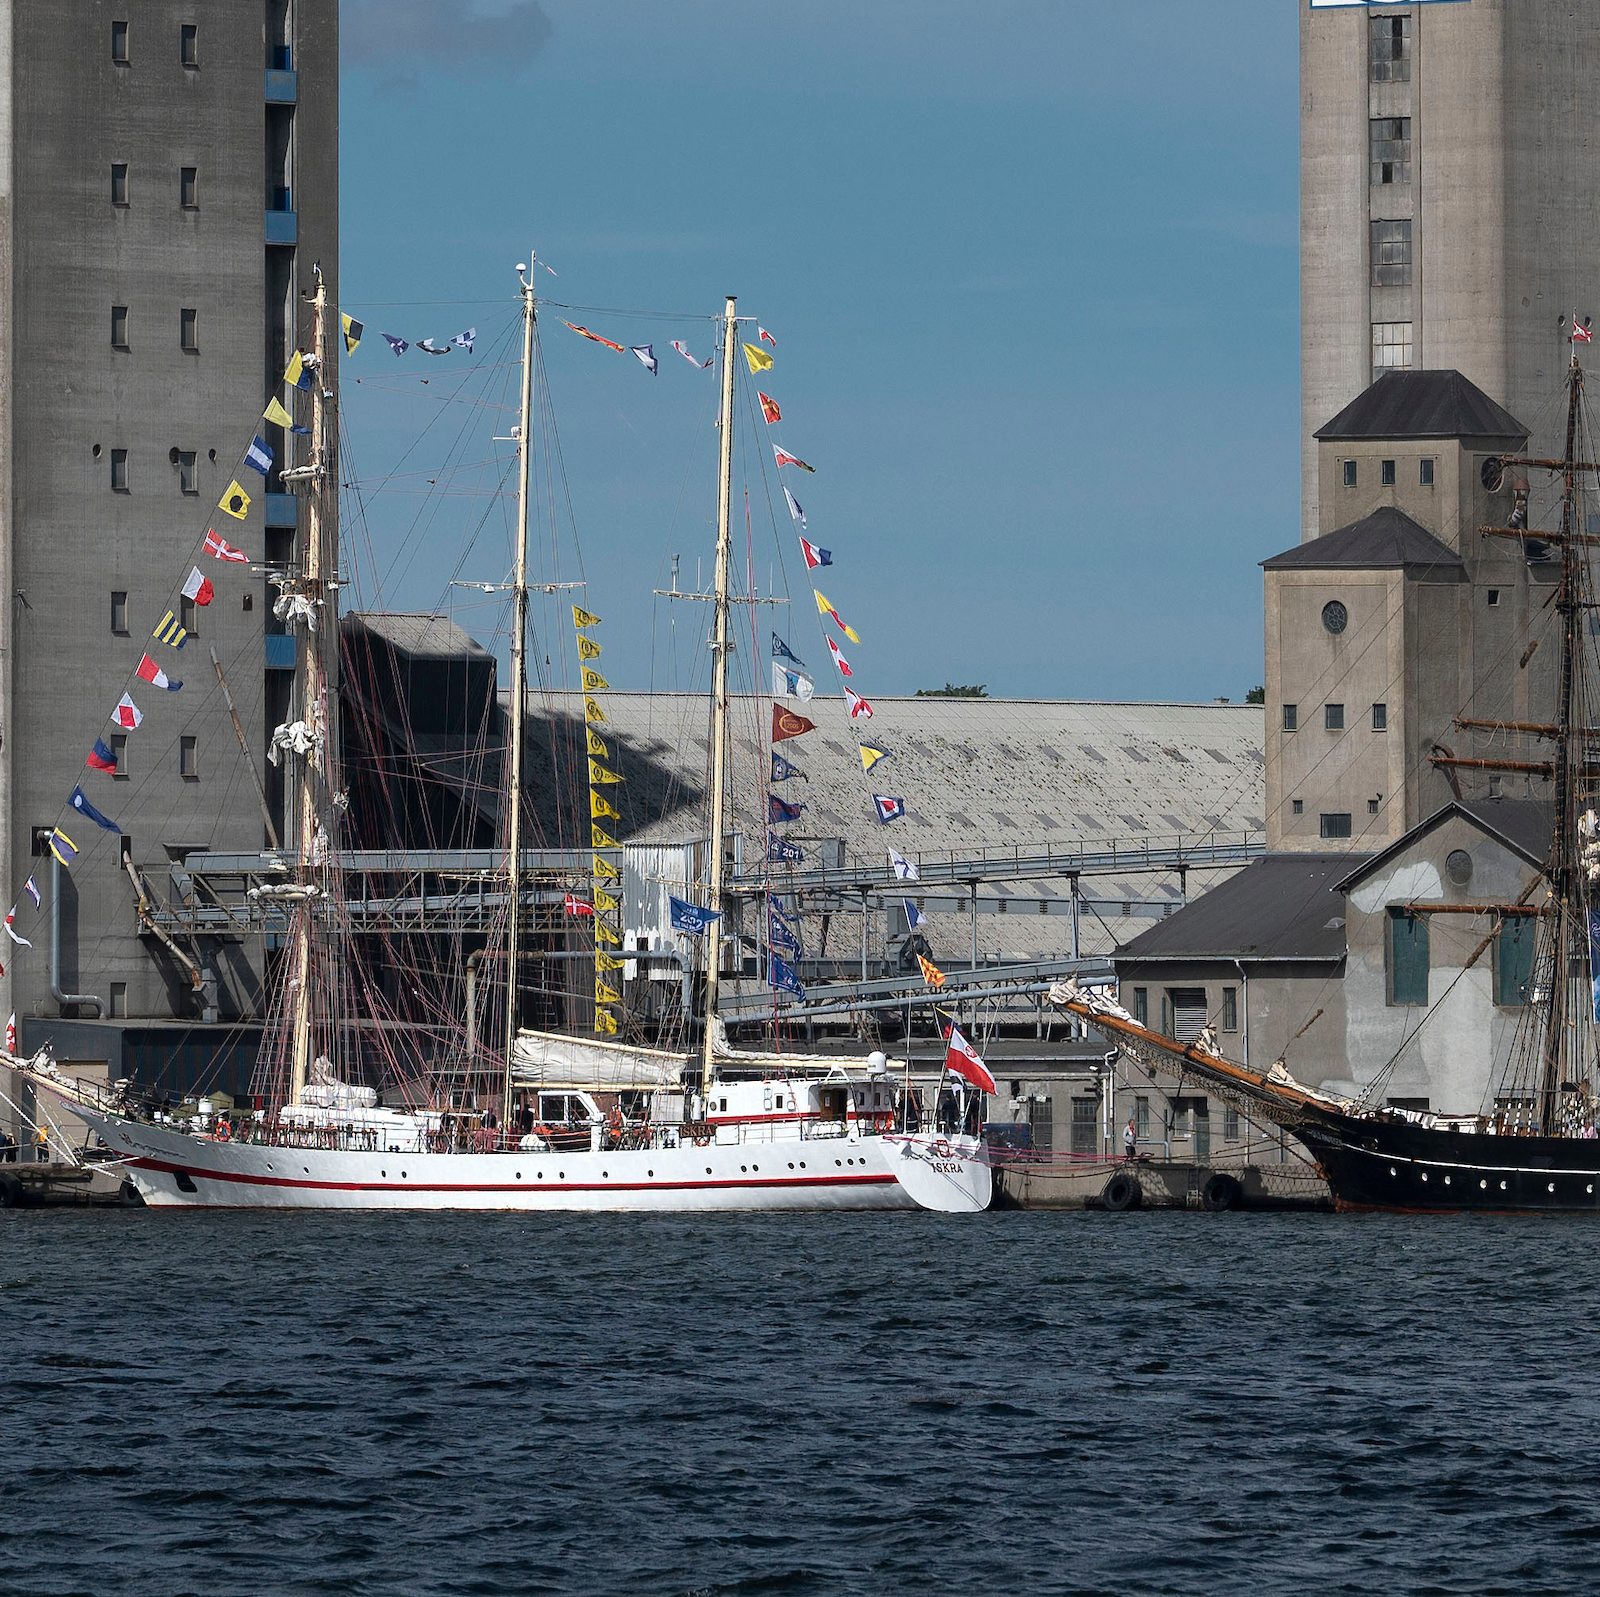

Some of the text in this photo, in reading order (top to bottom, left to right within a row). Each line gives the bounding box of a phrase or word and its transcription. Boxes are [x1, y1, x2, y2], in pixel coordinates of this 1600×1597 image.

[782, 847, 800, 859] 201
[680, 1125, 715, 1136] ISKRA
[932, 1162, 964, 1173] ISKRA
